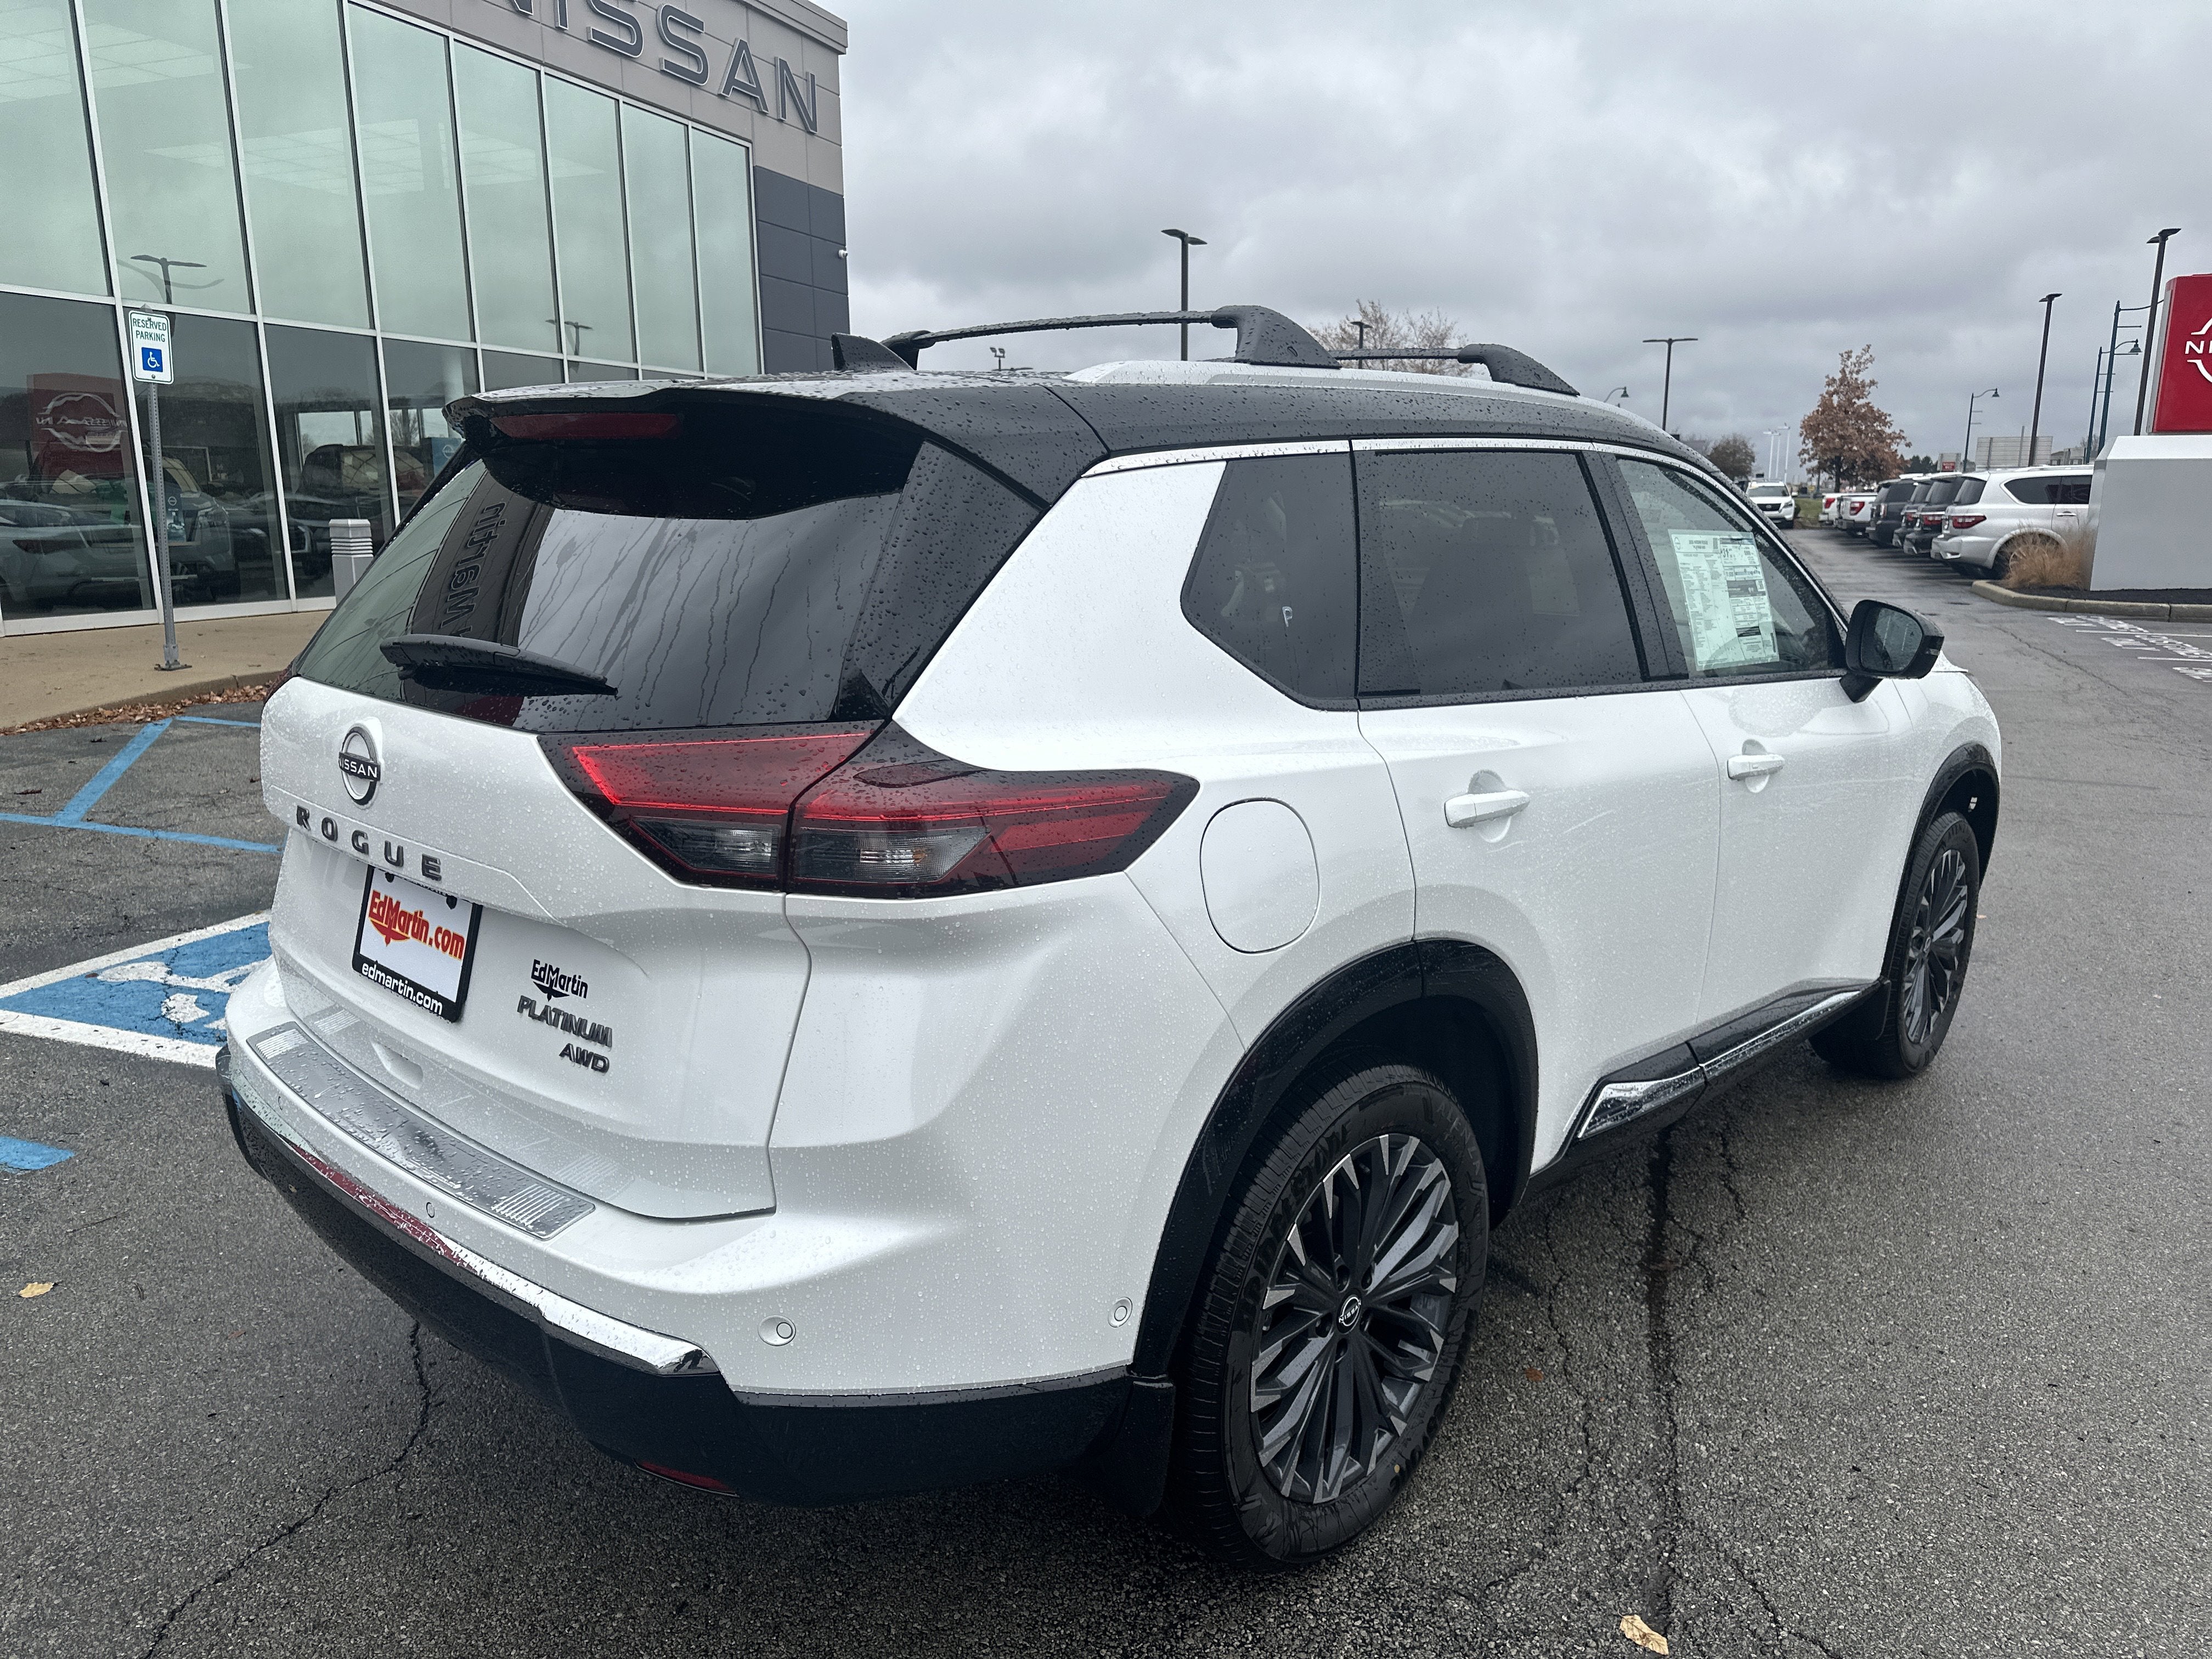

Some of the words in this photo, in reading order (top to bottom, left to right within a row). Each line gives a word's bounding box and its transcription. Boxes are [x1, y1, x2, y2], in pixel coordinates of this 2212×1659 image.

[510, 0, 817, 134] SSAN
[133, 318, 167, 331] RESERVED
[136, 330, 166, 342] PARKING
[338, 756, 377, 778] NISSAN
[296, 805, 442, 881] ROGUE
[369, 889, 466, 961] EdMartin.com
[362, 963, 443, 1015] edmartin.com
[531, 958, 588, 999] EdMartin
[517, 995, 613, 1048] PLATINUM
[558, 1043, 610, 1074] AWD
[1338, 1299, 1362, 1323] NISSAN
